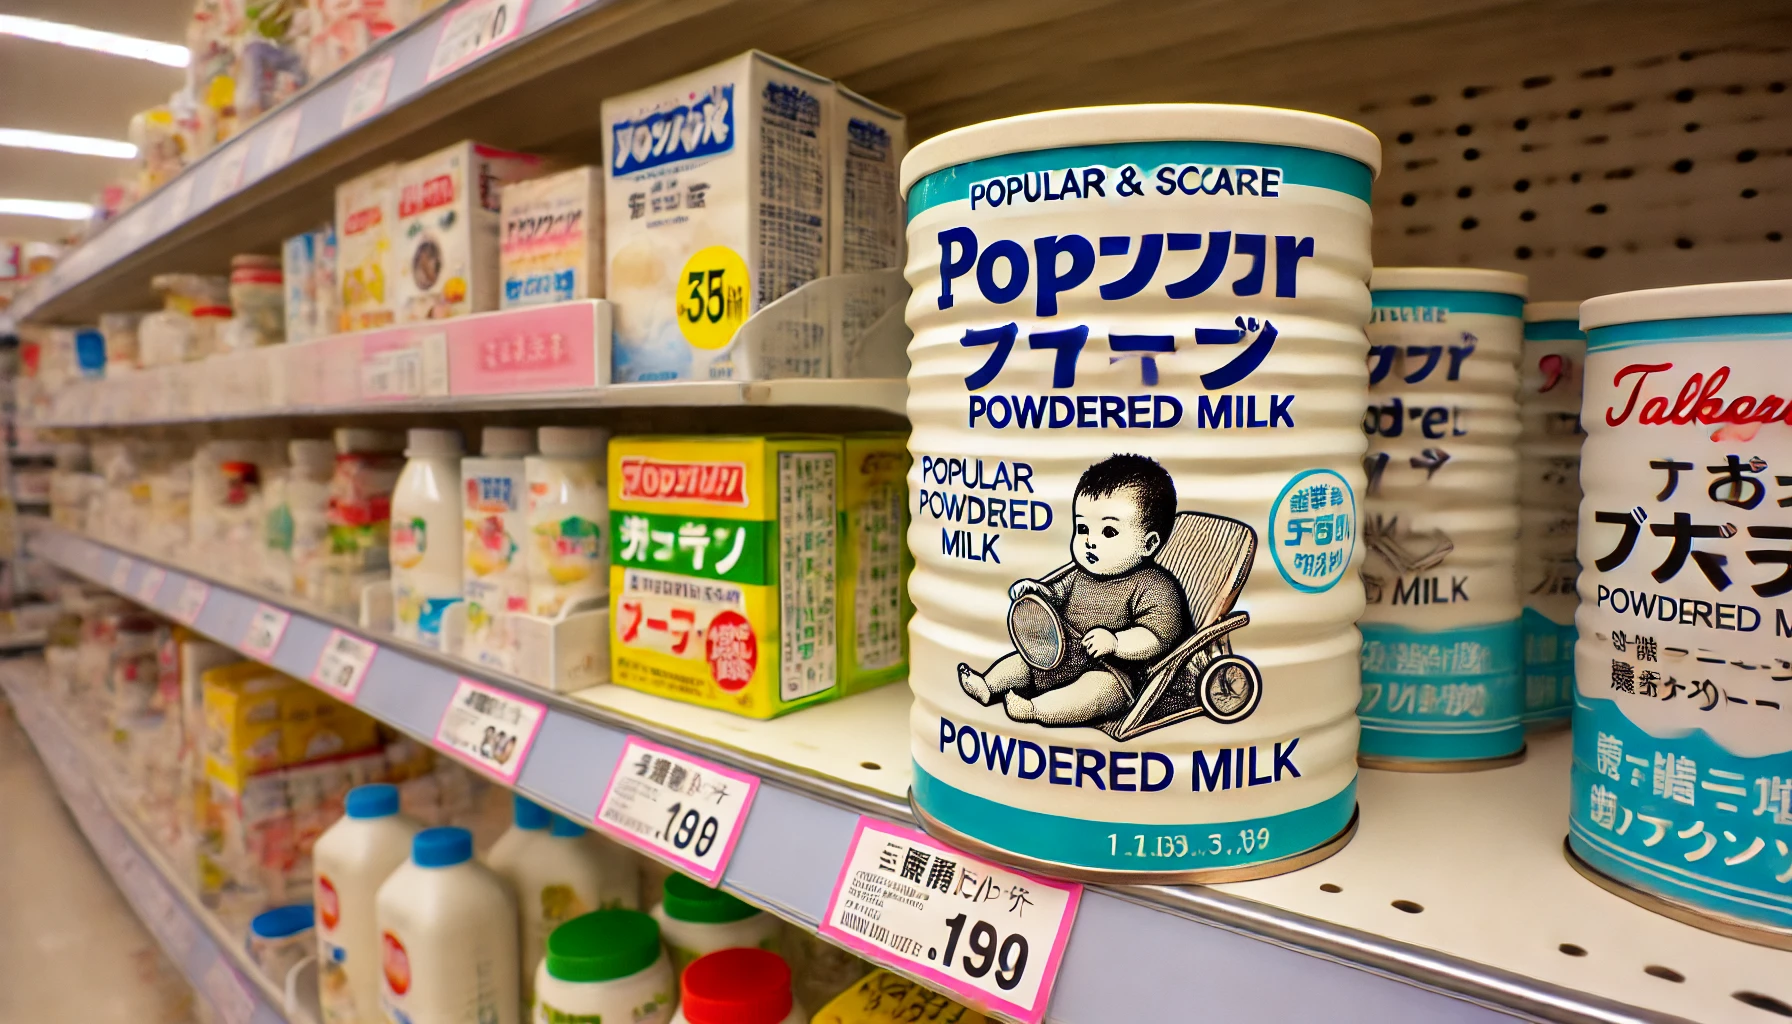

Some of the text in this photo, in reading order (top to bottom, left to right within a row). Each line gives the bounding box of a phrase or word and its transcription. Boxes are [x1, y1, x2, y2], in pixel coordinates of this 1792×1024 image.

[971, 167, 1106, 210] POPULAR
[1116, 165, 1145, 197] &
[969, 394, 1295, 429] POWDERED MILK
[922, 455, 1034, 493] POPULAR
[942, 527, 1001, 565] MILK
[1392, 575, 1470, 606] MILK
[1597, 584, 1761, 632] POWDERED
[939, 716, 1302, 793] POWDERED MILK
